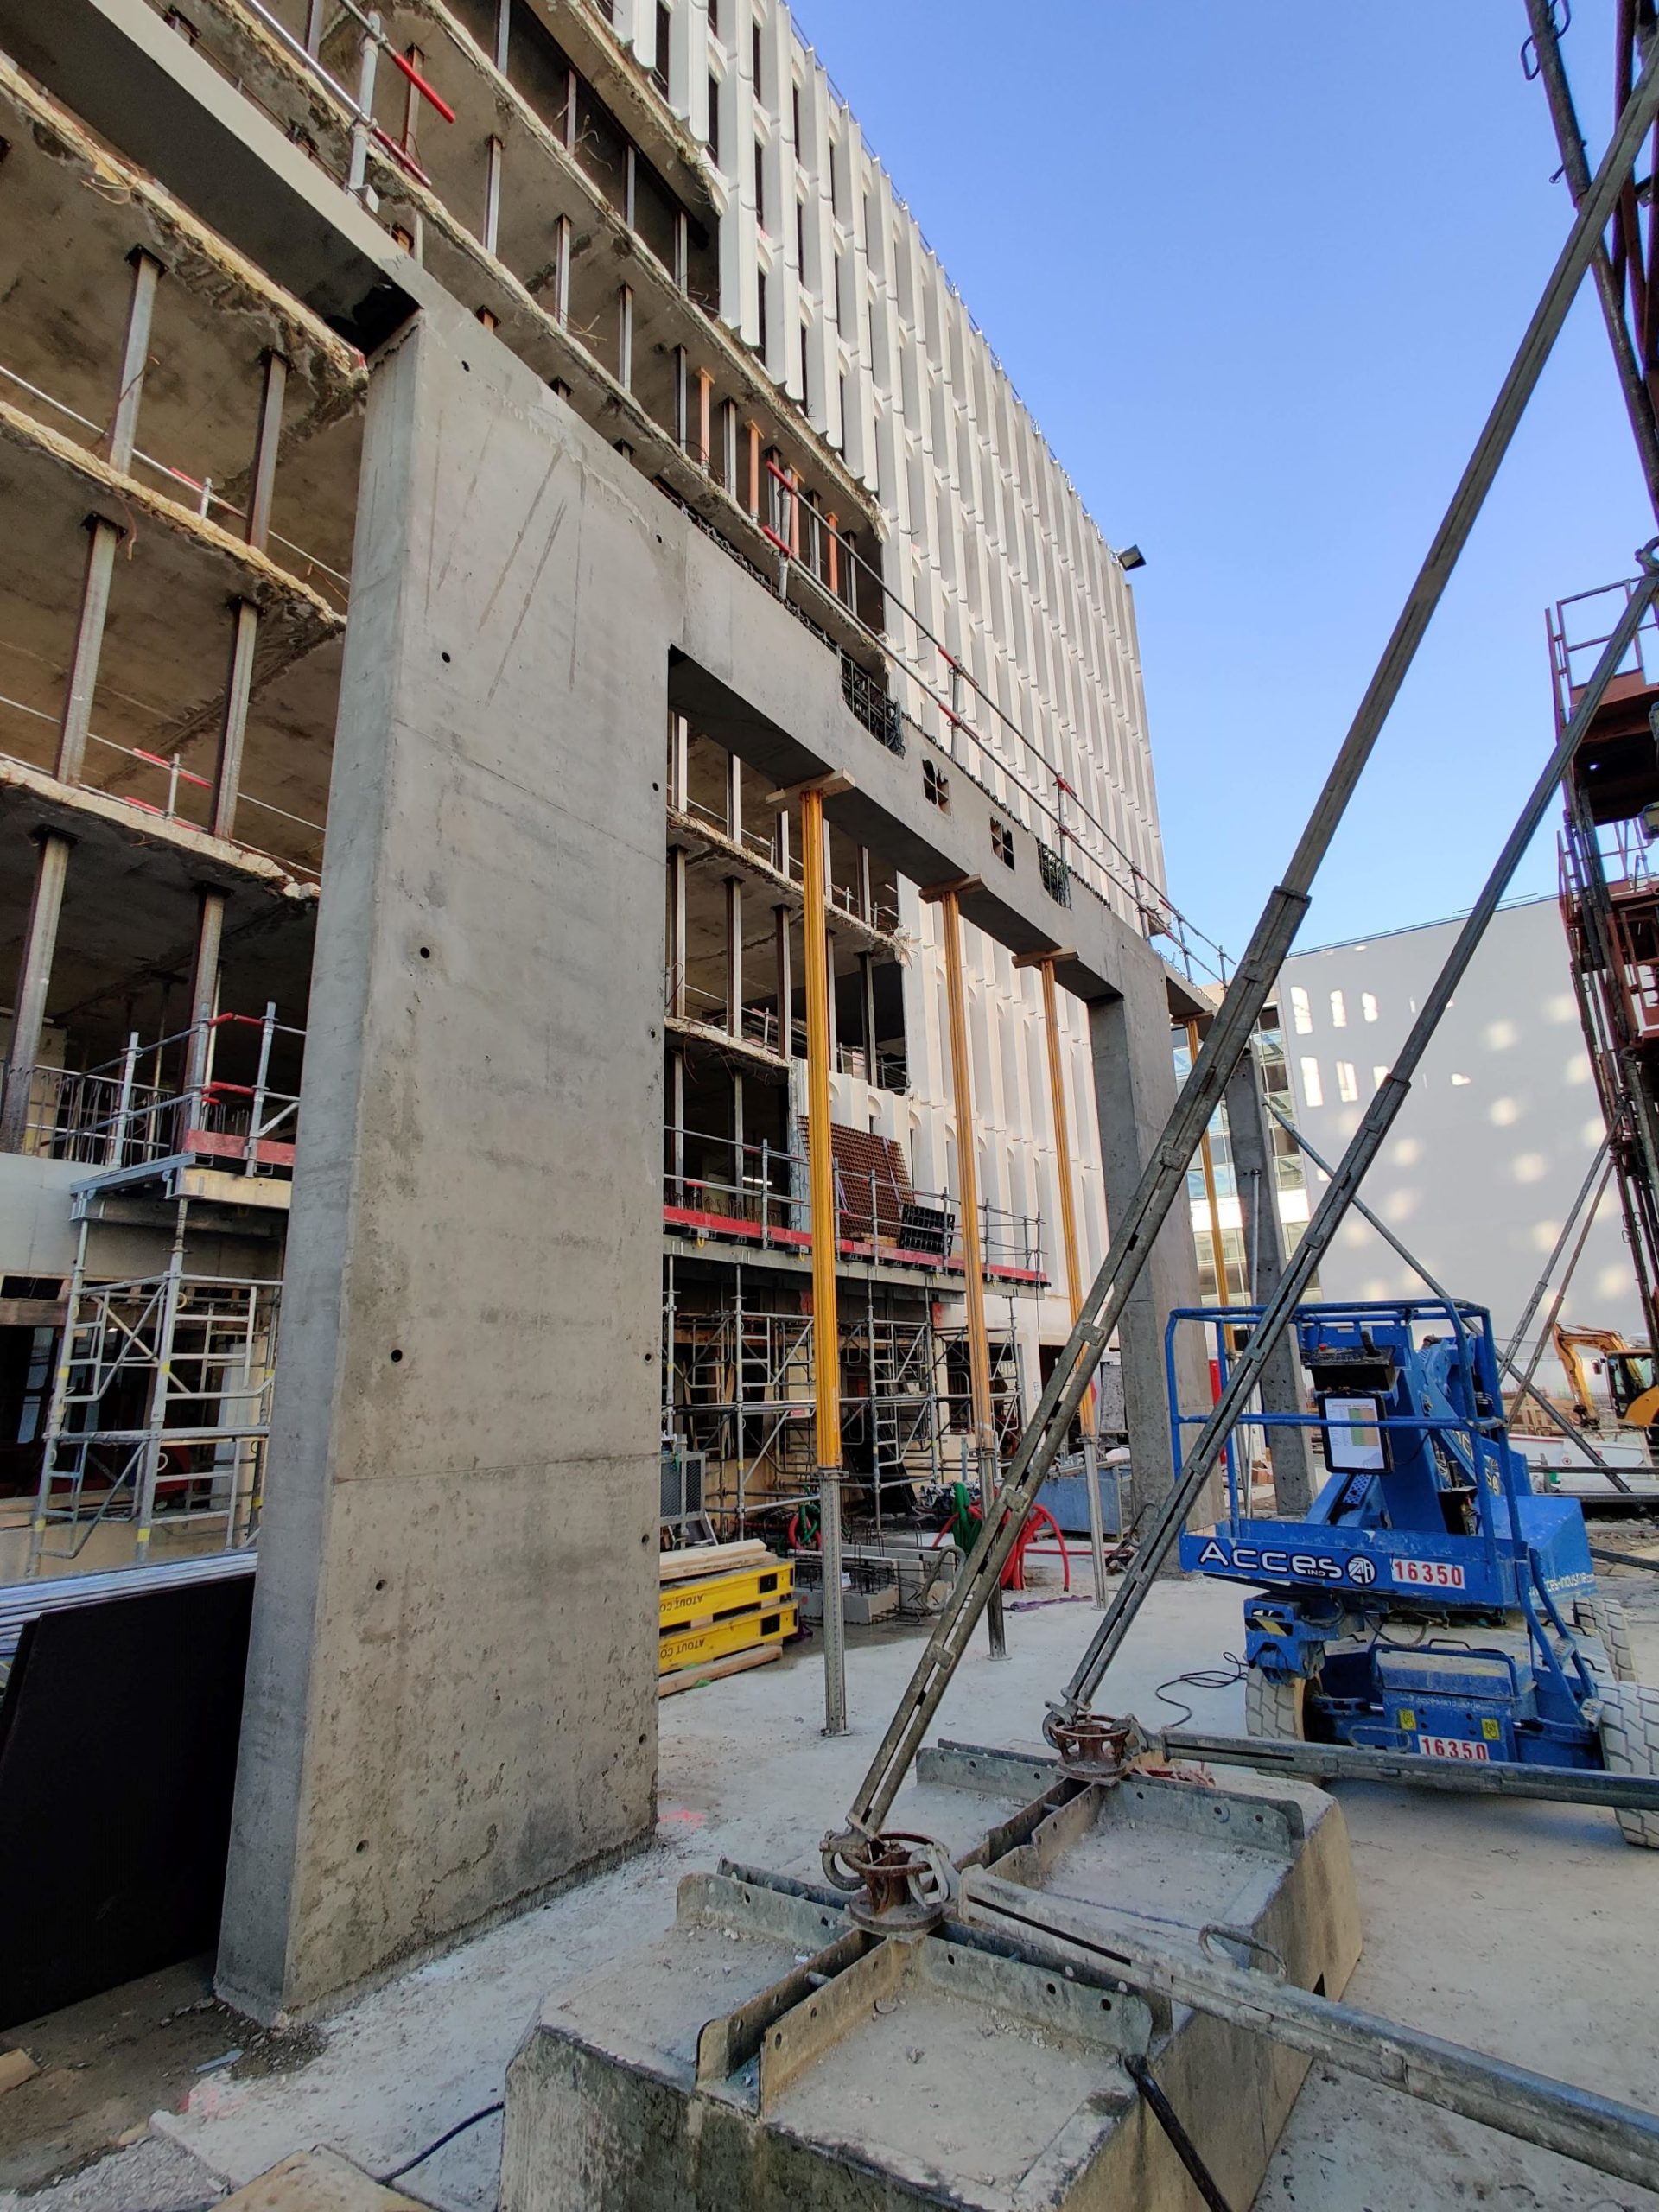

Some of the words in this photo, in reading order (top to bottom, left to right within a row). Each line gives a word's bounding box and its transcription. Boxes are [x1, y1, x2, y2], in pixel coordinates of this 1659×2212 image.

[1200, 1541, 1342, 1579] Acces
[1394, 1560, 1462, 1586] 16350
[675, 1593, 704, 1609] ATOUT
[676, 1638, 705, 1654] ATOUT
[1421, 1738, 1487, 1760] 16350
